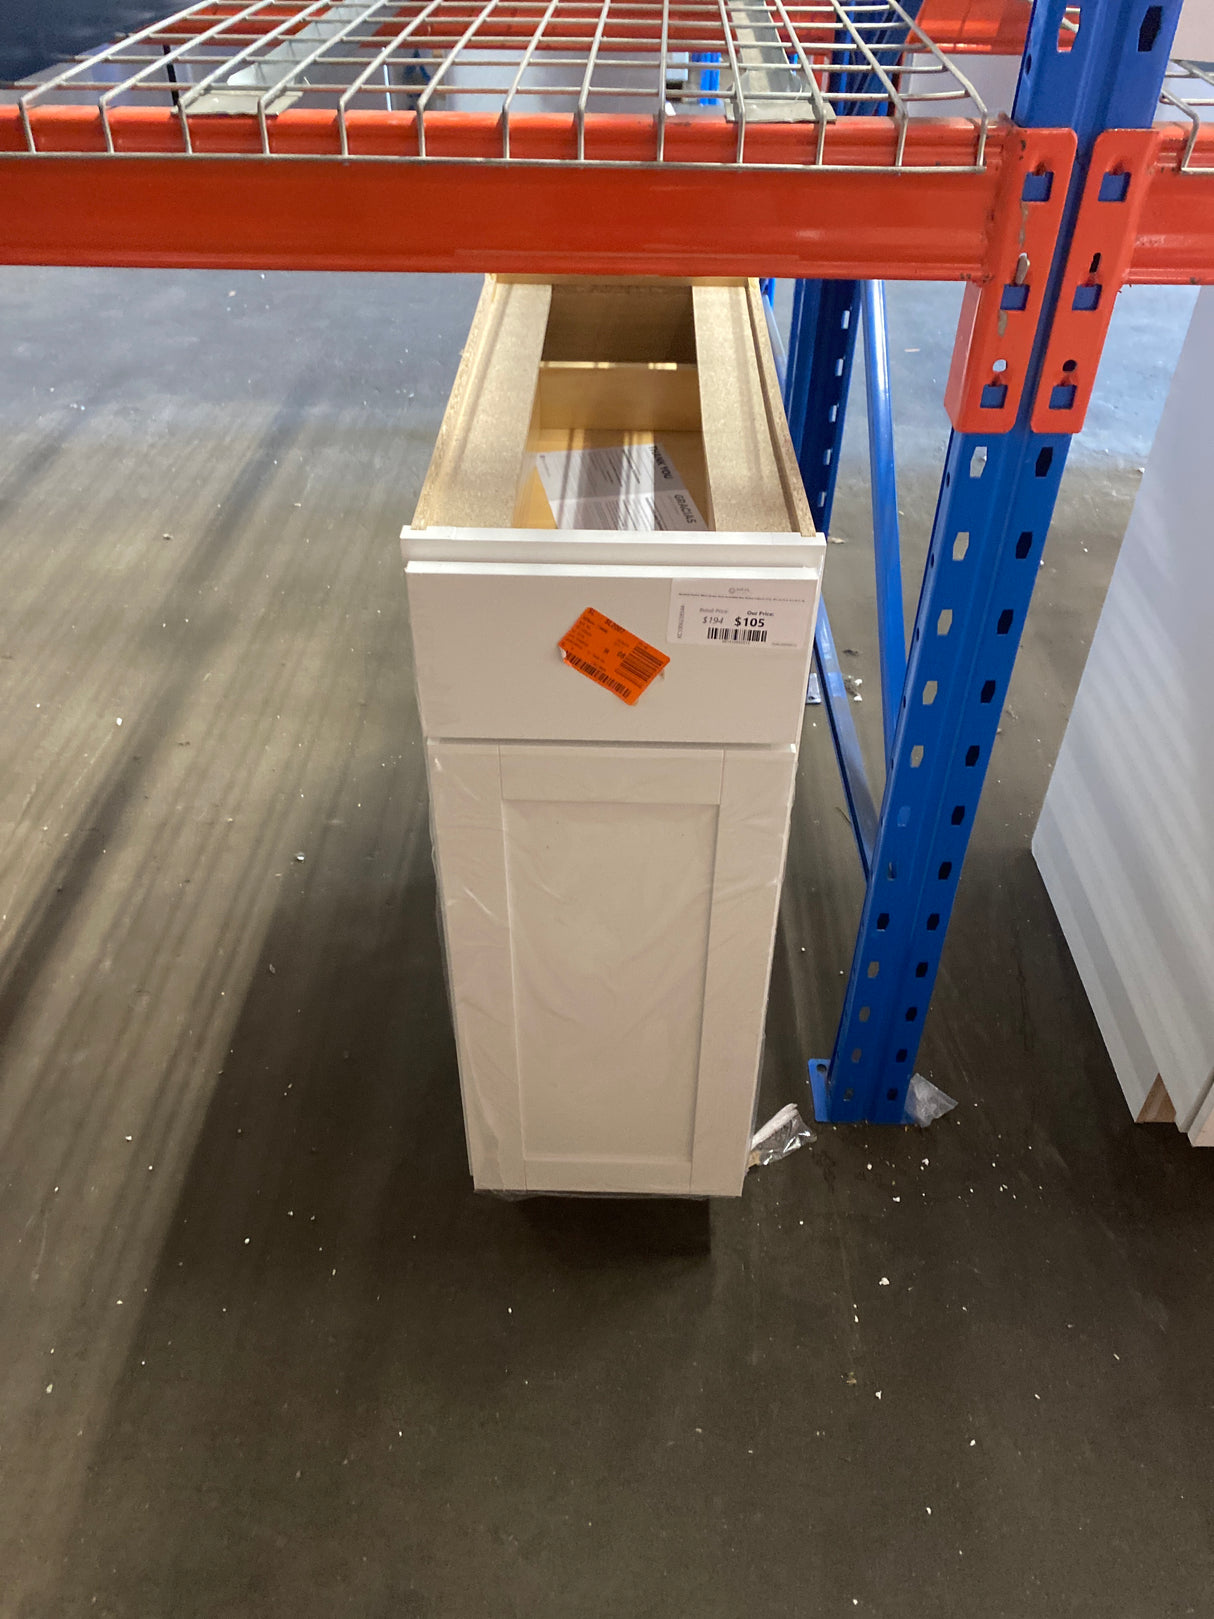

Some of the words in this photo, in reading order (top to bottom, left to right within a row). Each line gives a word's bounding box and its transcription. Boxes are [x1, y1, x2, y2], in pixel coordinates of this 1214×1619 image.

[649, 445, 665, 466] THANK
[659, 465, 674, 479] YOU
[674, 494, 697, 524] GRACIAS
[702, 616, 724, 625] $194
[734, 616, 765, 628] $105
